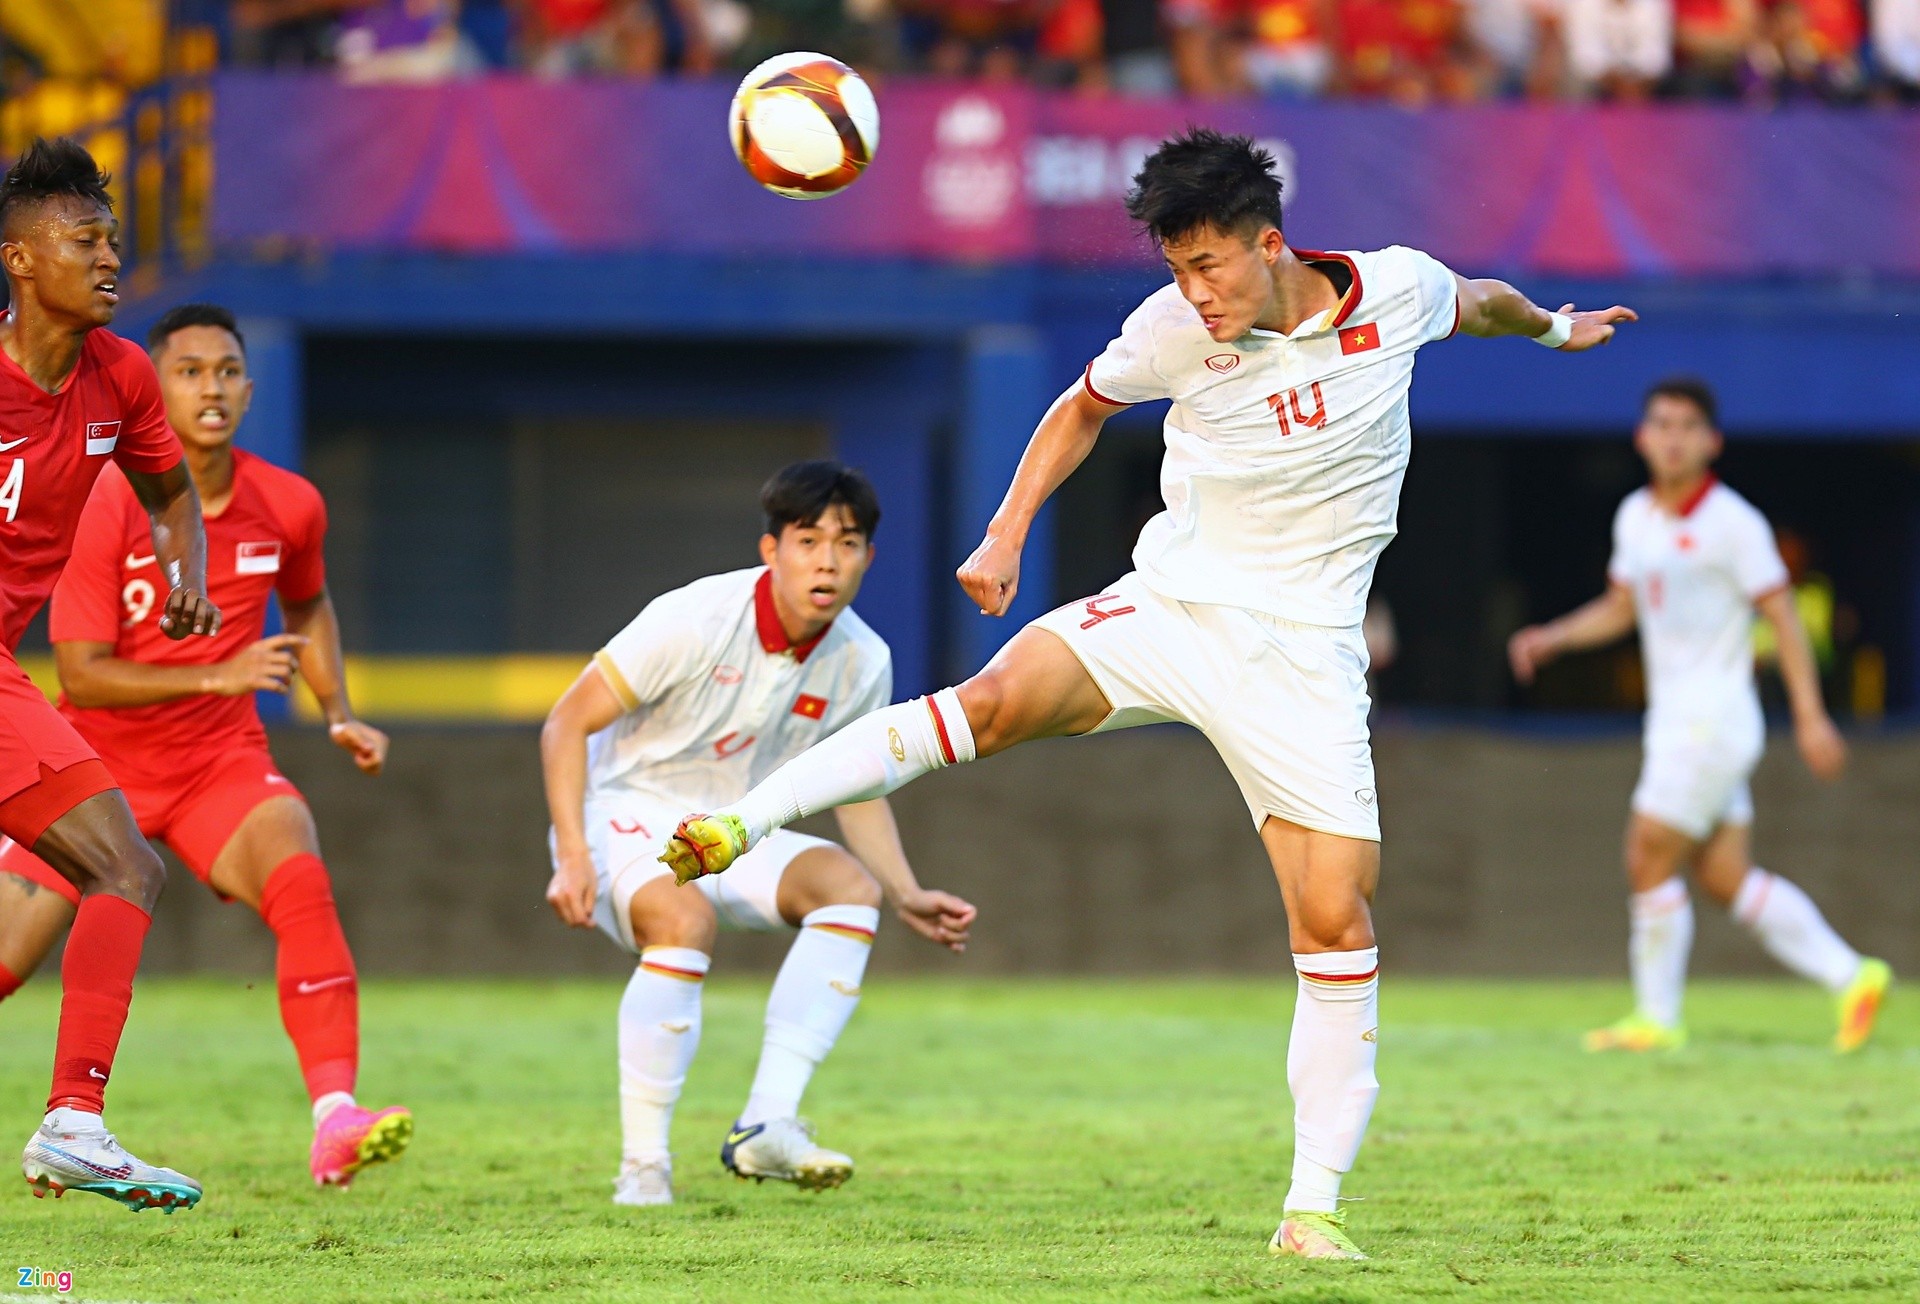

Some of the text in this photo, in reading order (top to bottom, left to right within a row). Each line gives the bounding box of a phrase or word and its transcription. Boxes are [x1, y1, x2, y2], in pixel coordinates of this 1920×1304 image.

[1266, 381, 1327, 436] 14
[0, 457, 25, 523] 4
[123, 579, 156, 628] 9
